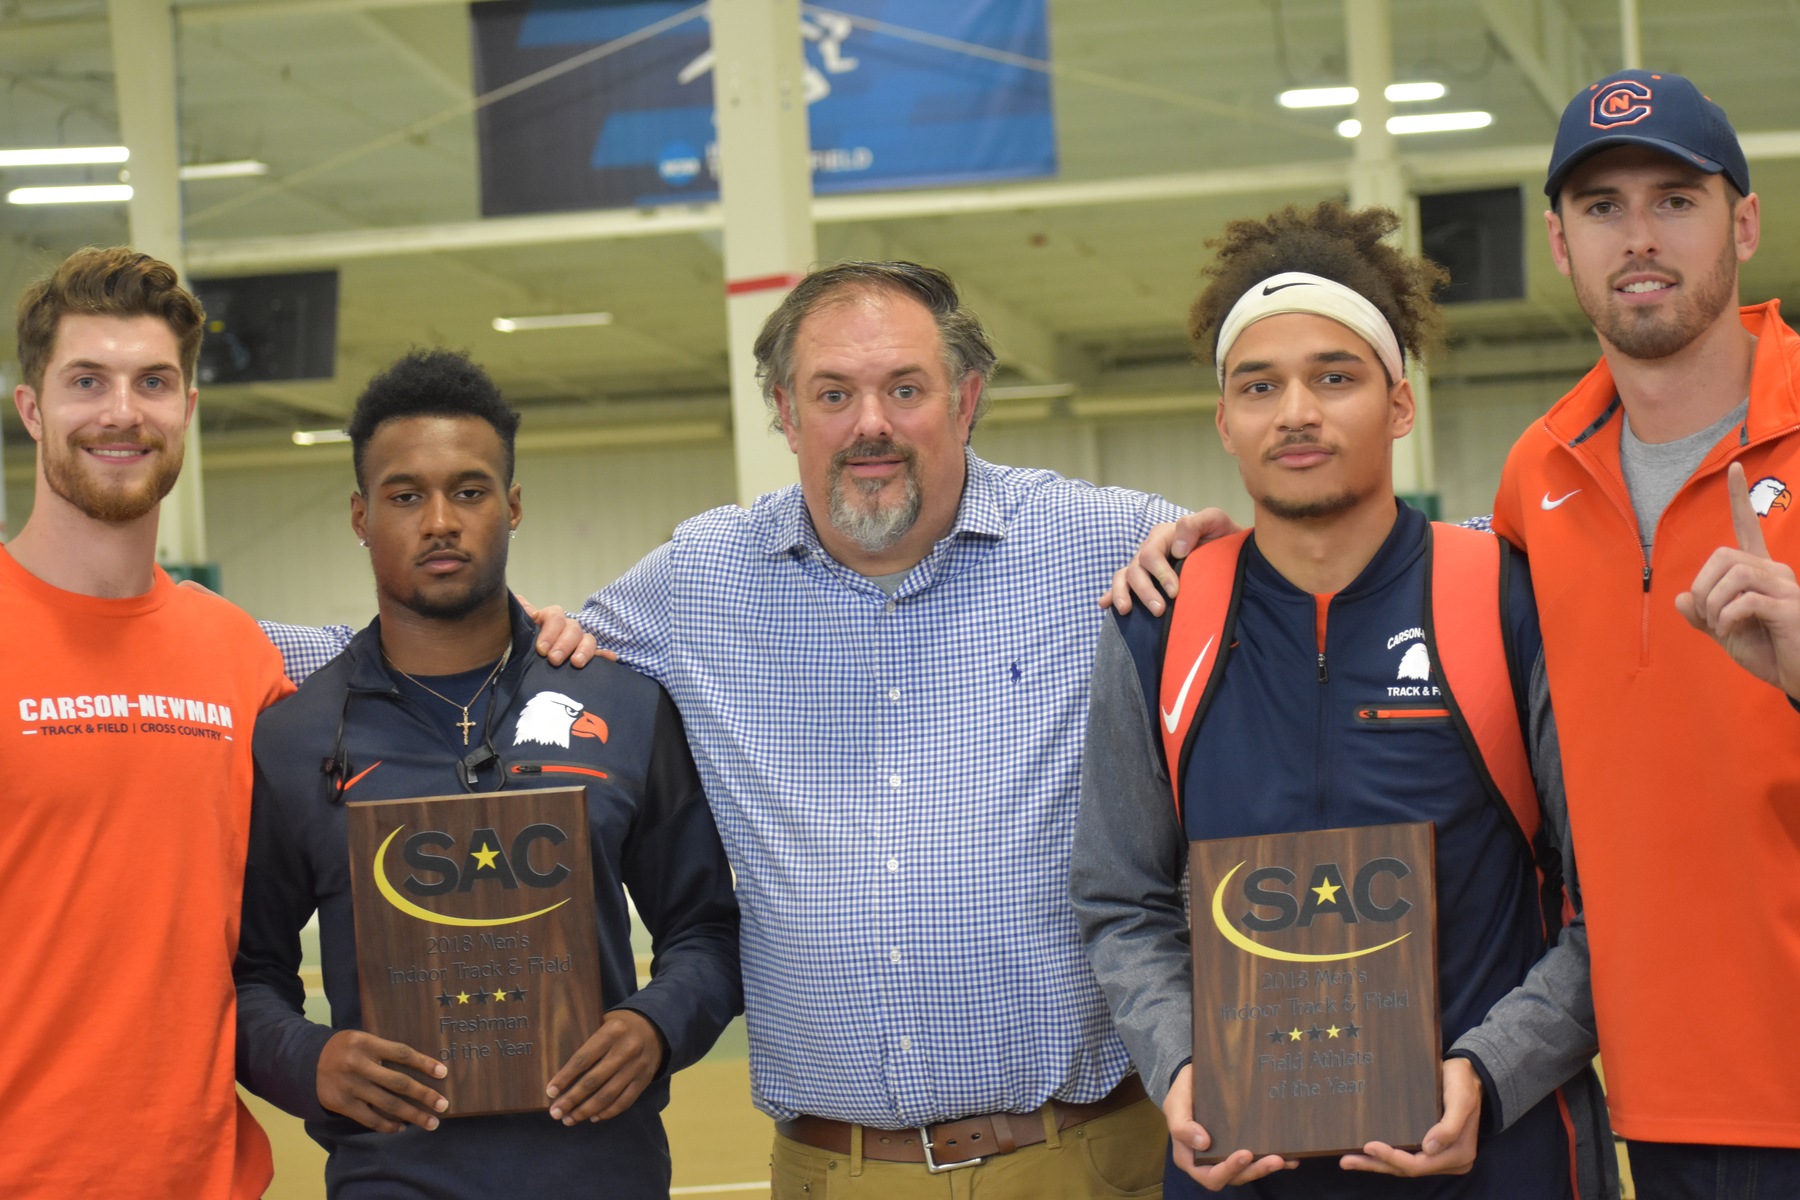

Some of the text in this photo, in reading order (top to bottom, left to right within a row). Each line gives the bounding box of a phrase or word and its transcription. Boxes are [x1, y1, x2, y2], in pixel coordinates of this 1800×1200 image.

[1387, 687, 1420, 696] TRACK
[1422, 687, 1430, 695] &
[19, 694, 232, 728] CARSON-NEWMAN
[40, 724, 82, 737] TRACK
[85, 724, 94, 734] &
[97, 723, 128, 733] FIELD
[140, 722, 176, 734] CROSS
[177, 726, 222, 741] COUNTRY
[403, 823, 571, 896] SAC
[1241, 857, 1413, 931] SAC
[426, 931, 530, 955] 2018 Men's
[387, 954, 573, 985] Indoor Track & Field
[1315, 967, 1368, 987] Men's
[1221, 991, 1409, 1022] Indoor Track & Field
[439, 1014, 529, 1035] Freshman
[440, 1039, 533, 1061] of the Year
[1258, 1049, 1374, 1073] Field Athlete
[1269, 1076, 1365, 1099] of the Year
